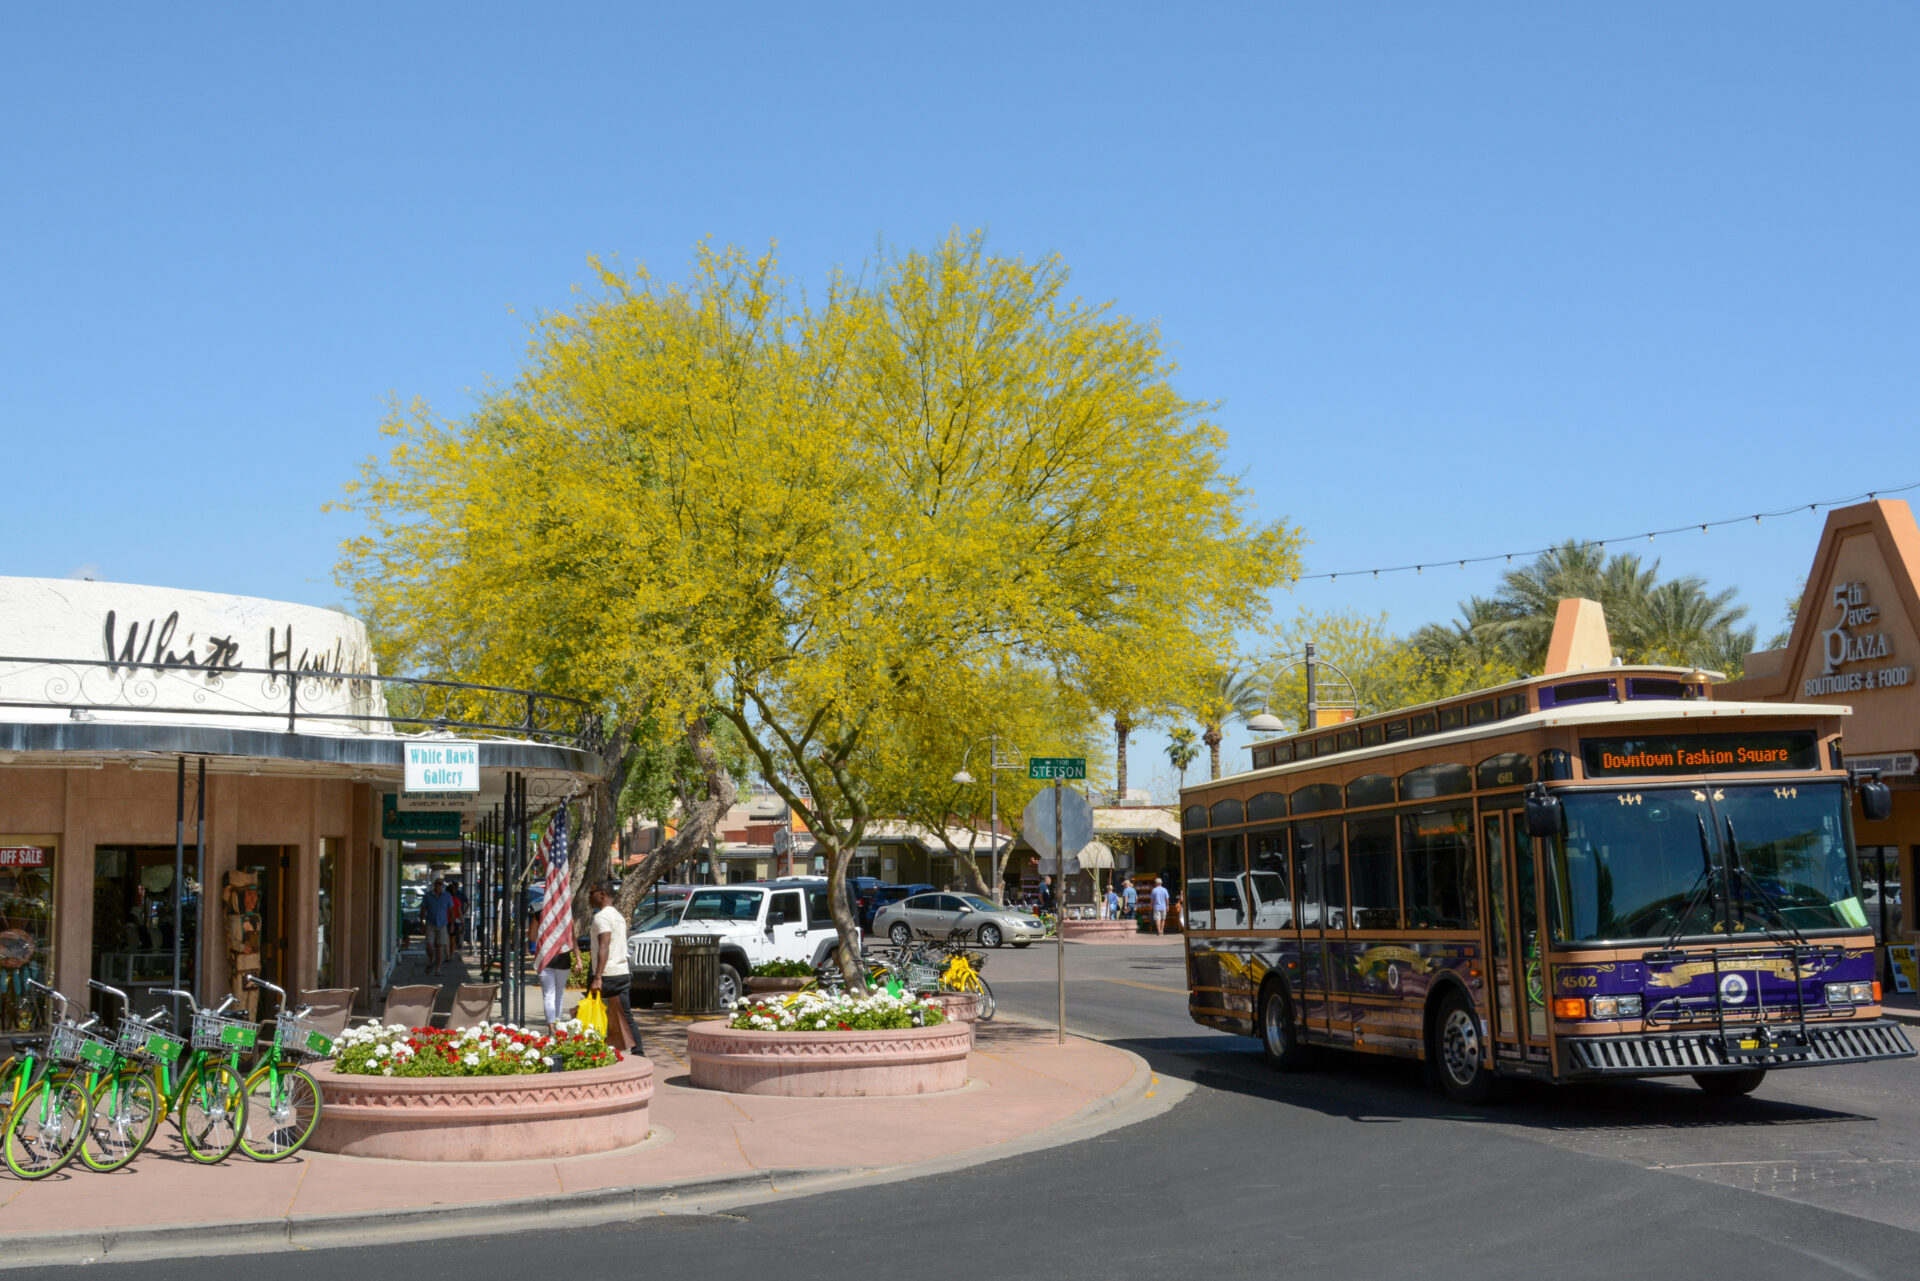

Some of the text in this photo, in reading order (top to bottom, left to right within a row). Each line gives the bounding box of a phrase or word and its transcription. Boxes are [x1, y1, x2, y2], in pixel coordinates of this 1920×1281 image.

[1833, 582, 1862, 632] 5th
[1848, 606, 1873, 627] ave
[105, 610, 243, 679] White
[1822, 628, 1888, 675] PLAZA
[1805, 667, 1908, 697] BOUTIQUES & FOOD
[410, 749, 474, 764] White Hawk
[1603, 747, 1788, 769] Downtown Fashion Square
[424, 769, 463, 786] Gallery
[1032, 766, 1083, 778] STETSON
[1497, 771, 1513, 785] 4502
[401, 790, 473, 801] White Hawk Gallery
[0, 850, 43, 864] OFF SALE
[1562, 975, 1598, 988] 4502
